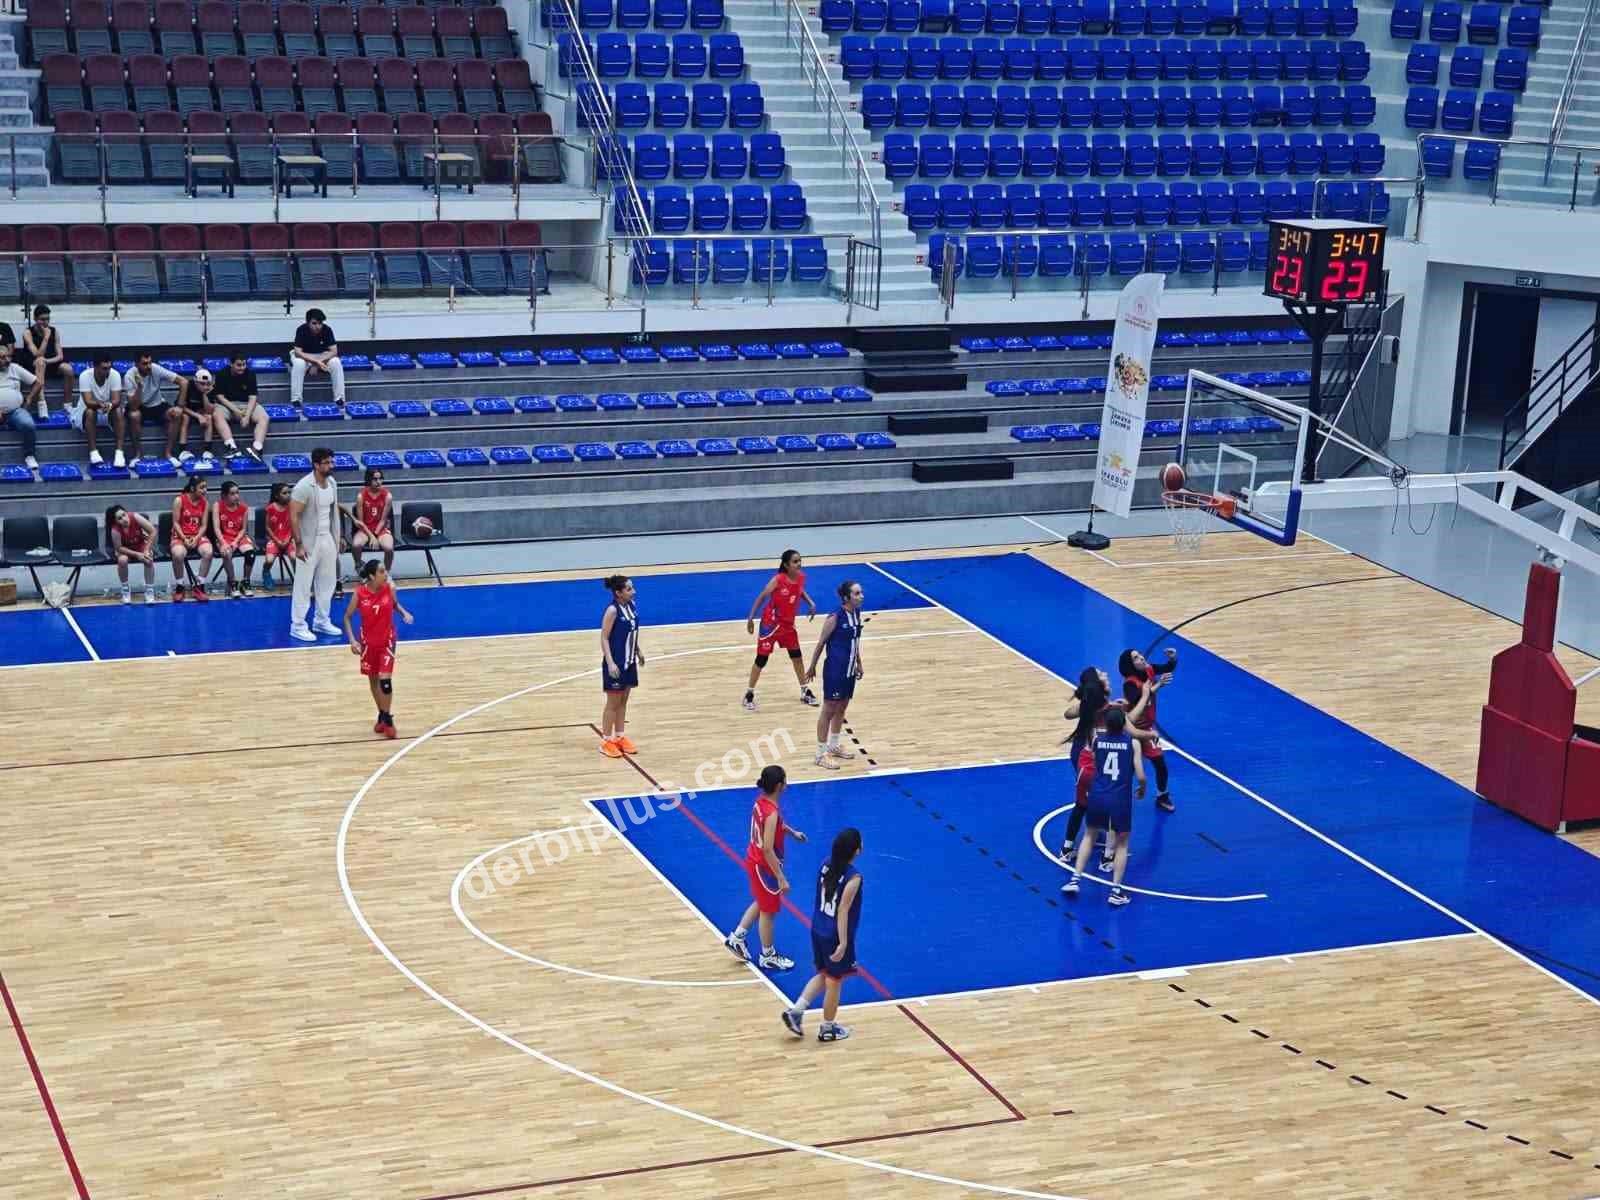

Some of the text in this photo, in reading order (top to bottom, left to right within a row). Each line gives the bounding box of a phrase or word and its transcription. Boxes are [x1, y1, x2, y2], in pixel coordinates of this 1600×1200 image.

[1279, 228, 1312, 254] 3:47
[1330, 233, 1380, 257] 3:47
[1272, 255, 1303, 295] 23
[1321, 260, 1369, 300] 23
[372, 604, 380, 615] 7
[383, 656, 391, 666] 7
[1103, 751, 1120, 781] 4
